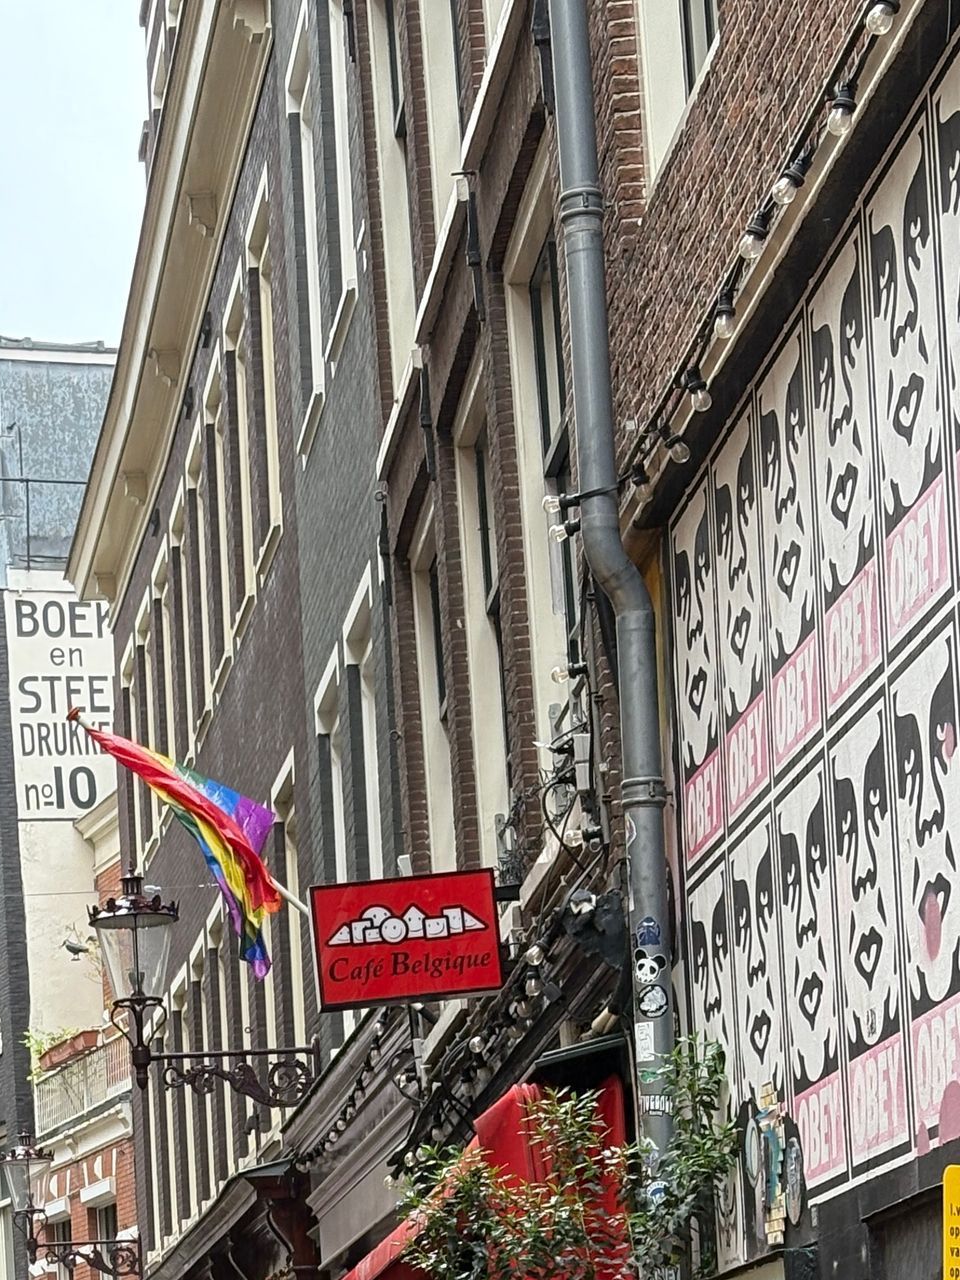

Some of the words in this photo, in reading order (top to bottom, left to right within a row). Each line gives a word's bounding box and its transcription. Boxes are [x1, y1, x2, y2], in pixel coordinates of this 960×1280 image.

[891, 485, 942, 625] OBEY
[50, 647, 83, 667] en
[829, 564, 877, 693] OBEY
[776, 636, 815, 753] OBEY
[729, 695, 764, 804] OBEY
[688, 754, 719, 851] OBEY
[329, 957, 385, 985] Café
[391, 951, 491, 978] Belgique
[853, 1041, 900, 1146] OBEY
[917, 1005, 960, 1111] OBE
[799, 1078, 839, 1175] OBEY
